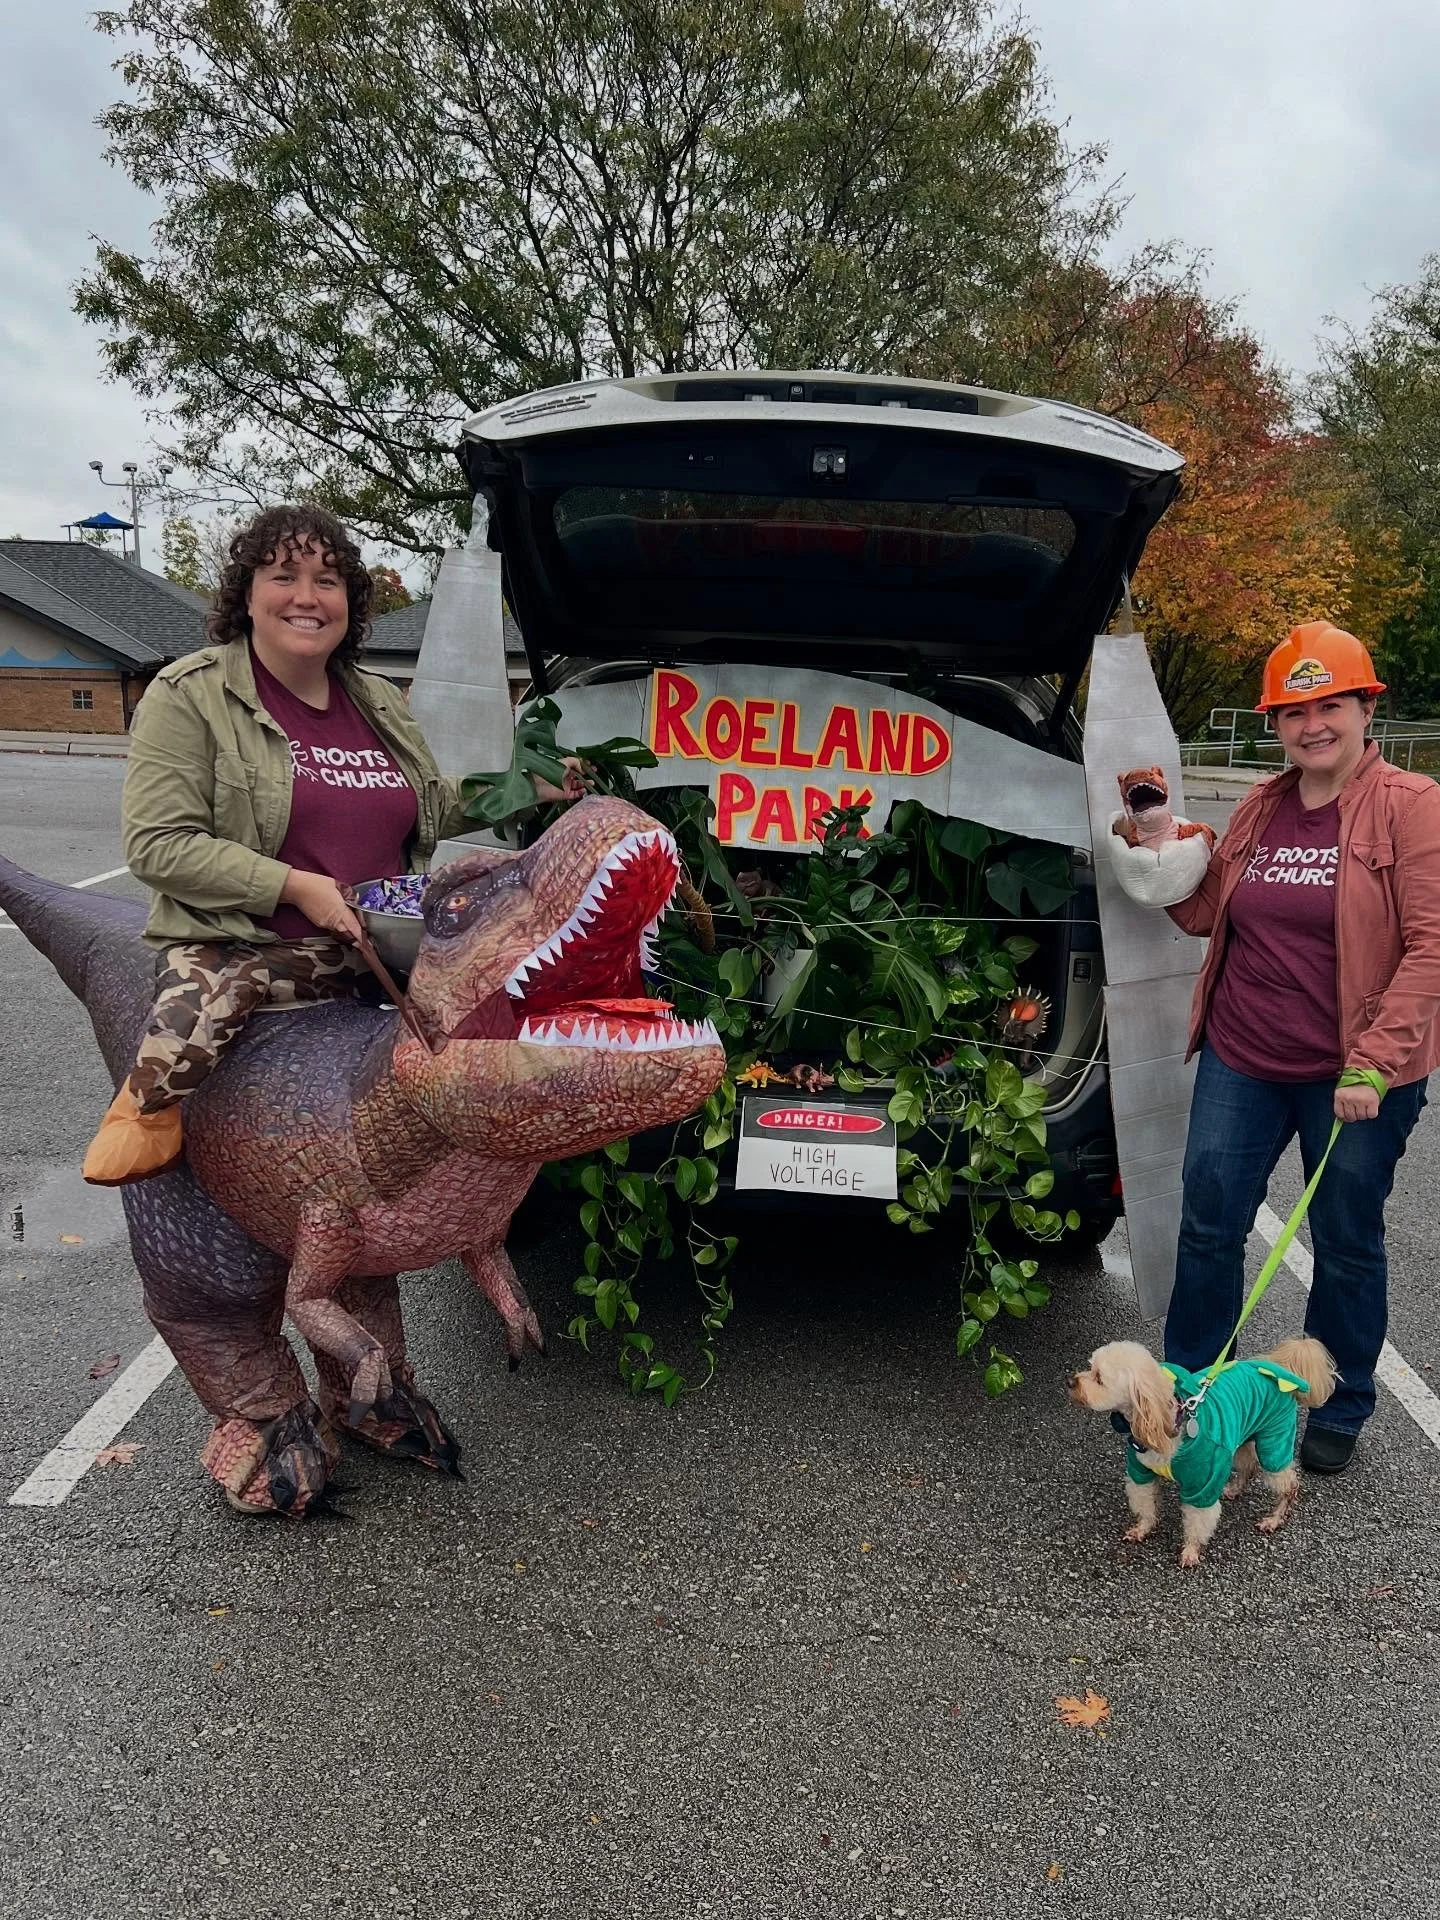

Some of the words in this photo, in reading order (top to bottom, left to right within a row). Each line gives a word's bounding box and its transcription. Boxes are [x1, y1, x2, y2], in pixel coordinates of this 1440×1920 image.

[653, 668, 951, 776] ROELAND
[310, 745, 389, 768] ROOTS
[320, 767, 409, 789] CHURCH
[1272, 846, 1339, 865] ROOTS
[1263, 866, 1336, 886] CHURC
[774, 1113, 843, 1129] DANGER!
[793, 1146, 836, 1166] HIGH
[770, 1163, 865, 1191] VOLTAGE
